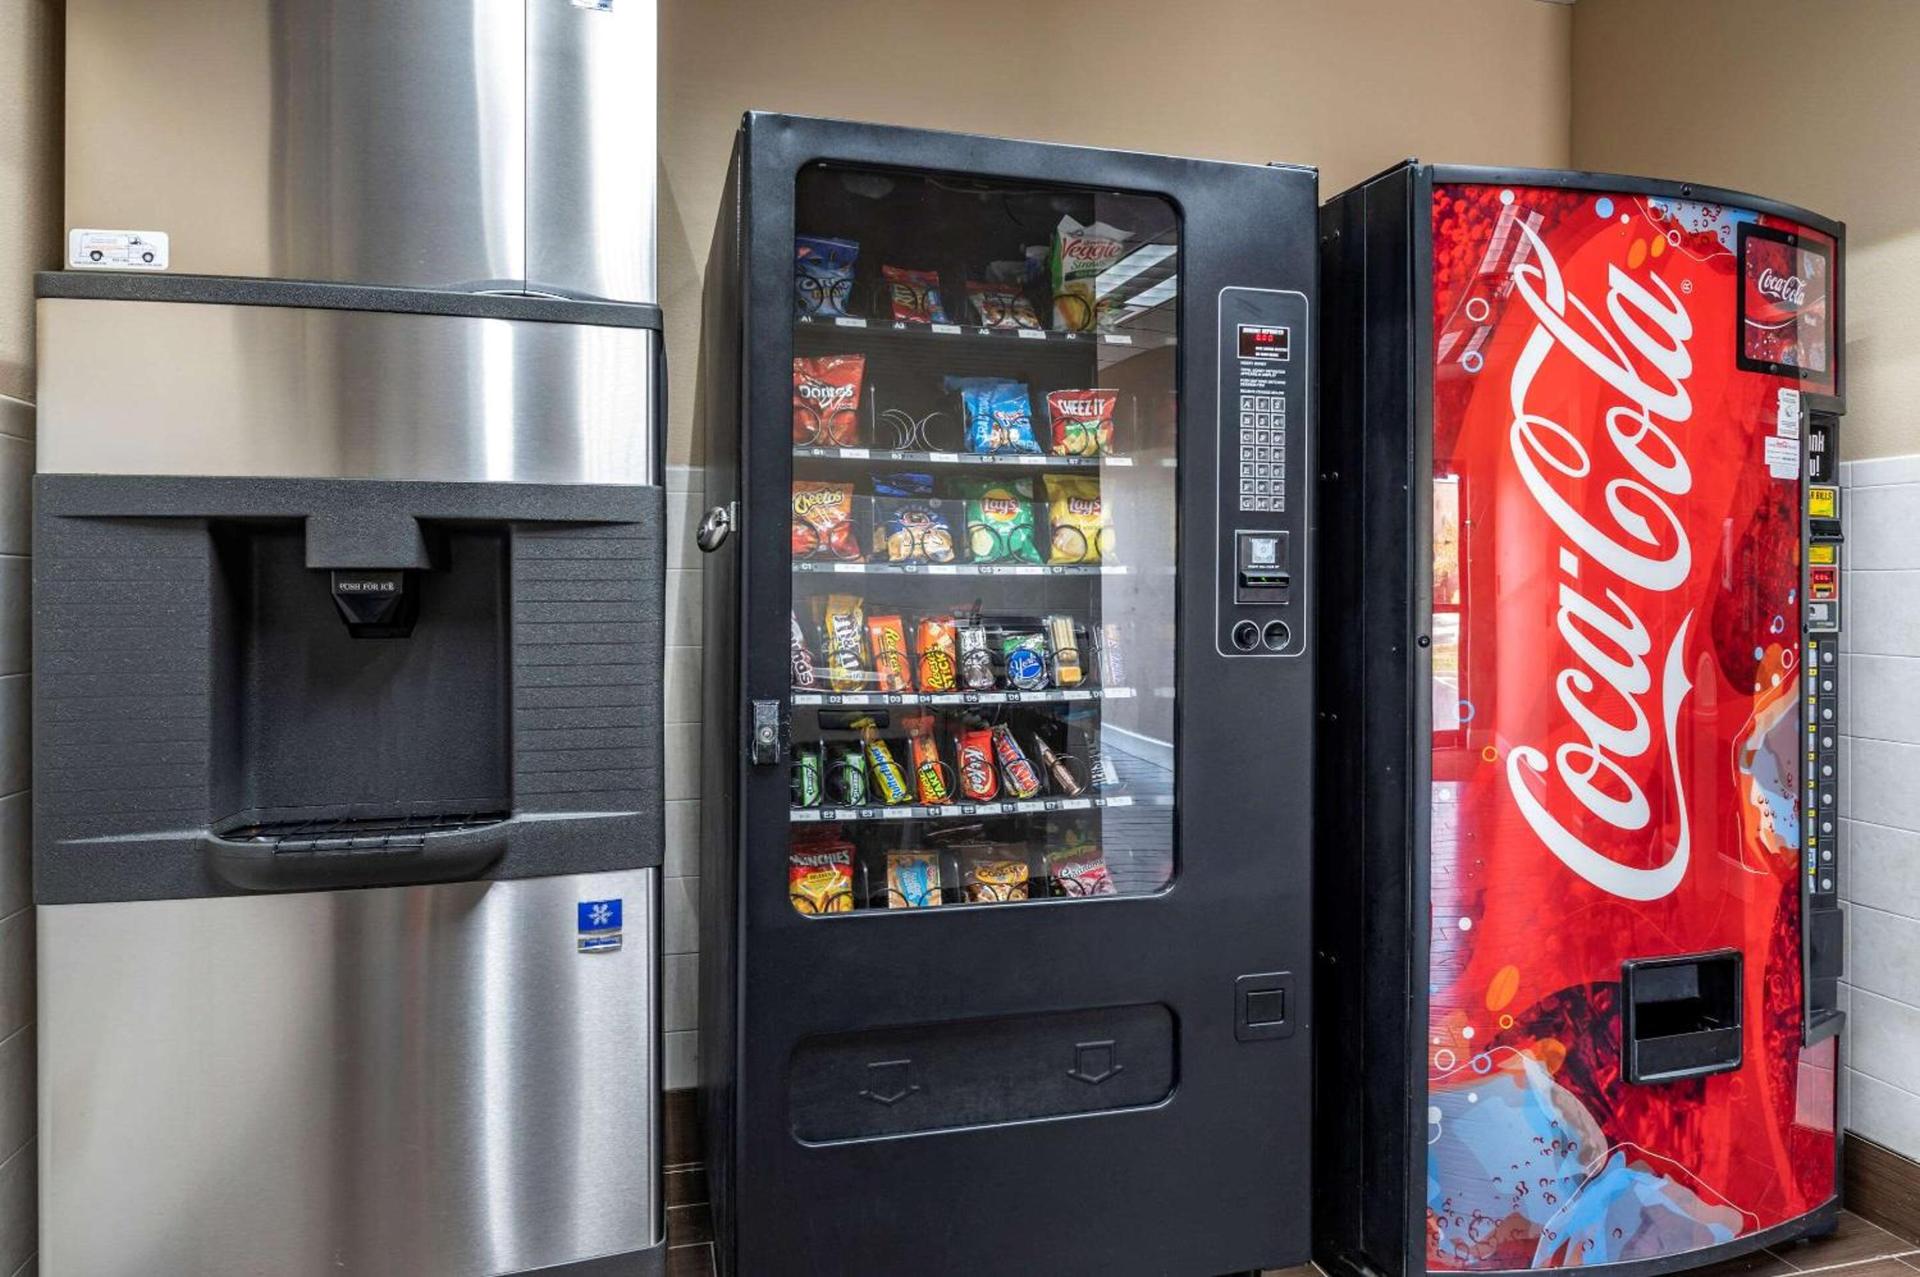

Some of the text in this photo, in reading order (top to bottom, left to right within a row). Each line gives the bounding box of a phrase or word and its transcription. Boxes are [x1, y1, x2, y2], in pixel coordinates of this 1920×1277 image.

[1062, 238, 1121, 260] Veggie
[1758, 268, 1806, 305] Coca-Cola
[798, 383, 854, 399] Doritos
[793, 489, 844, 514] Cheetos
[1507, 217, 1694, 900] Coca-Cola
[339, 581, 394, 592] PUSH FOR ICE
[885, 627, 902, 673] Reese's
[872, 748, 903, 798] Butterfinger
[823, 810, 833, 818] E2
[789, 849, 850, 867] MUNCHIES
